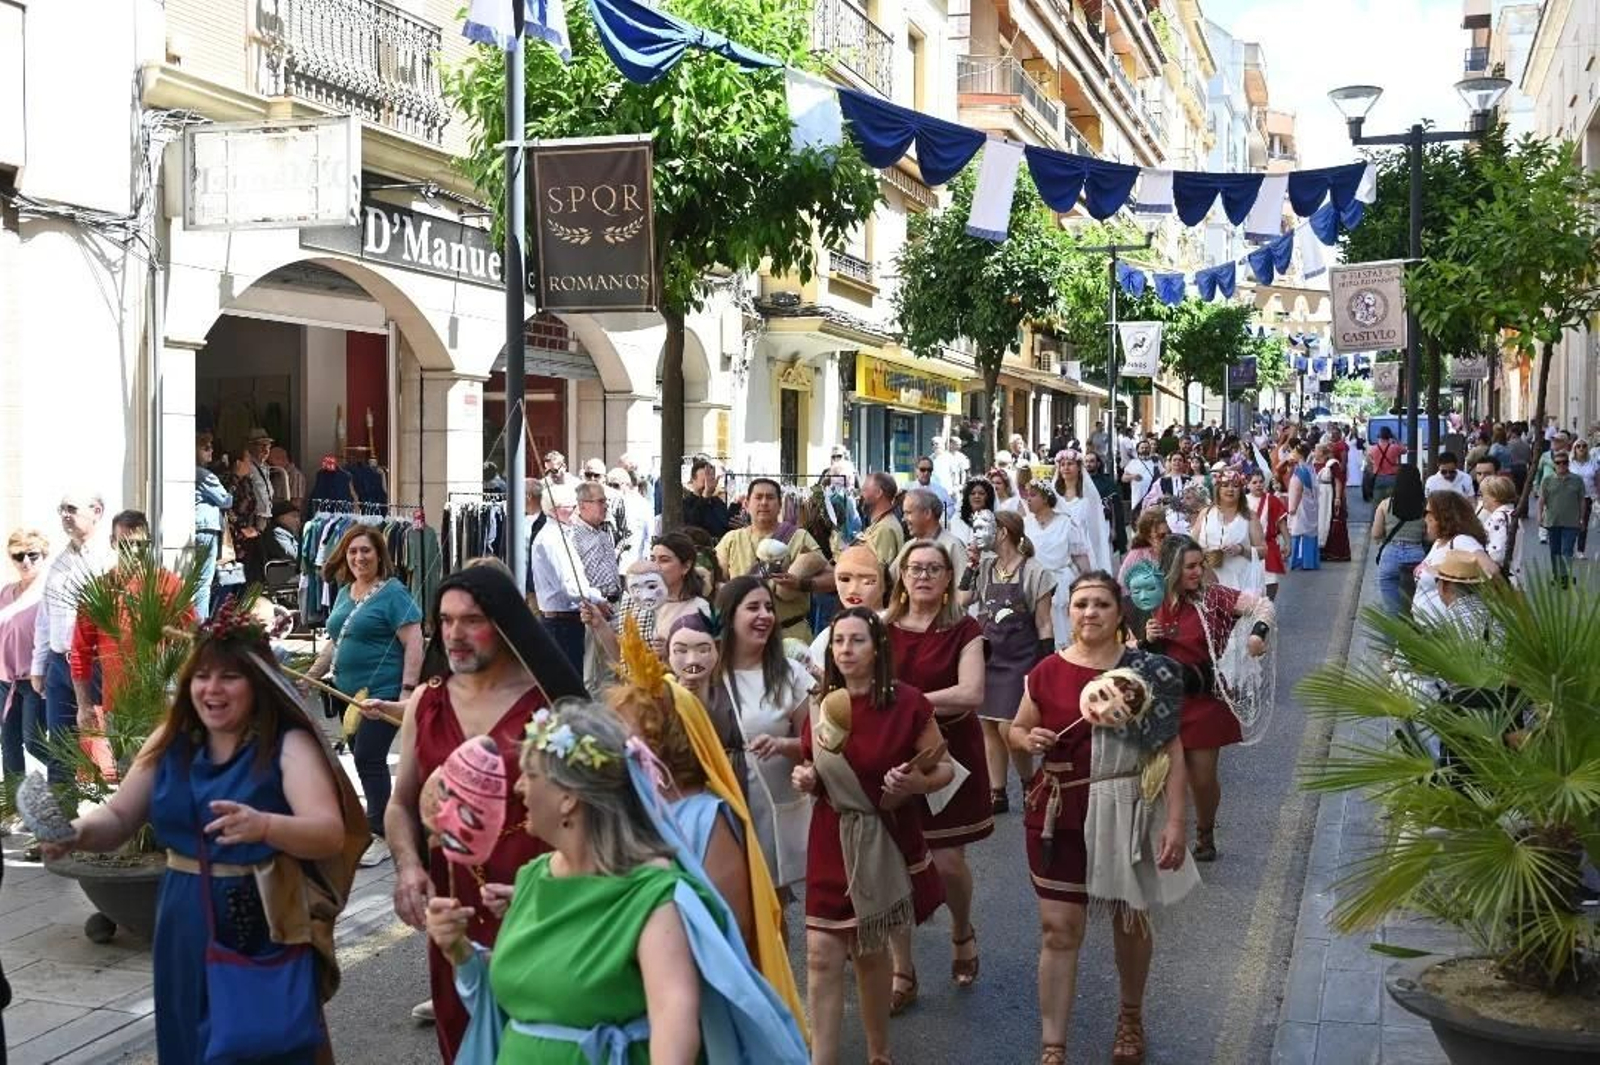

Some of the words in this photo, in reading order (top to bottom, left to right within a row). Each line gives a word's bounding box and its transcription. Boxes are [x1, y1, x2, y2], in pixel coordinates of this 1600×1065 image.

[364, 205, 501, 281] D'Manue
[550, 273, 650, 292] ROMANOS
[1342, 329, 1396, 343] CASTVLO
